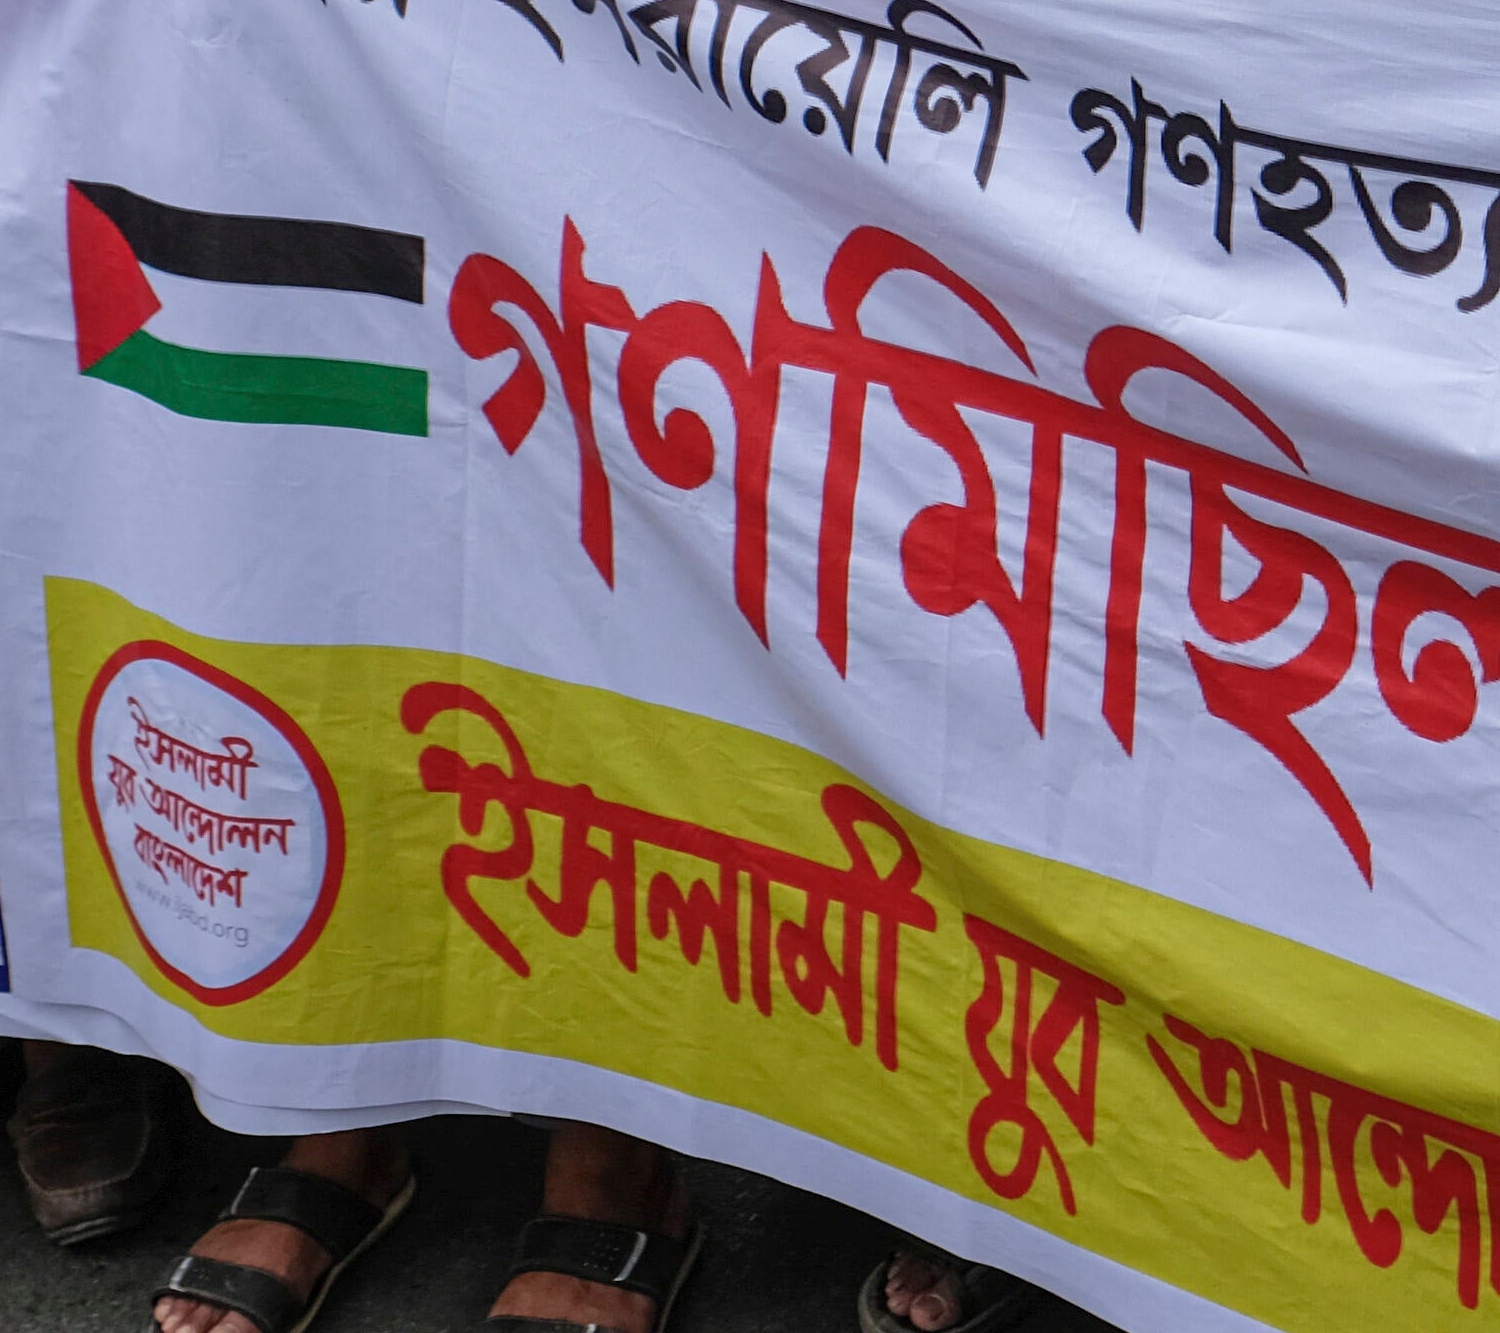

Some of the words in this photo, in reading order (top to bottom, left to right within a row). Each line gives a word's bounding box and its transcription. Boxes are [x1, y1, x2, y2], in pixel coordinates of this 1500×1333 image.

[127, 696, 259, 801] ইসলামী
[141, 776, 295, 857] আন্দোলন
[134, 823, 249, 908] বাংলাদেশ
[400, 680, 937, 1073] ইসলামী
[963, 913, 1126, 1218] যুব
